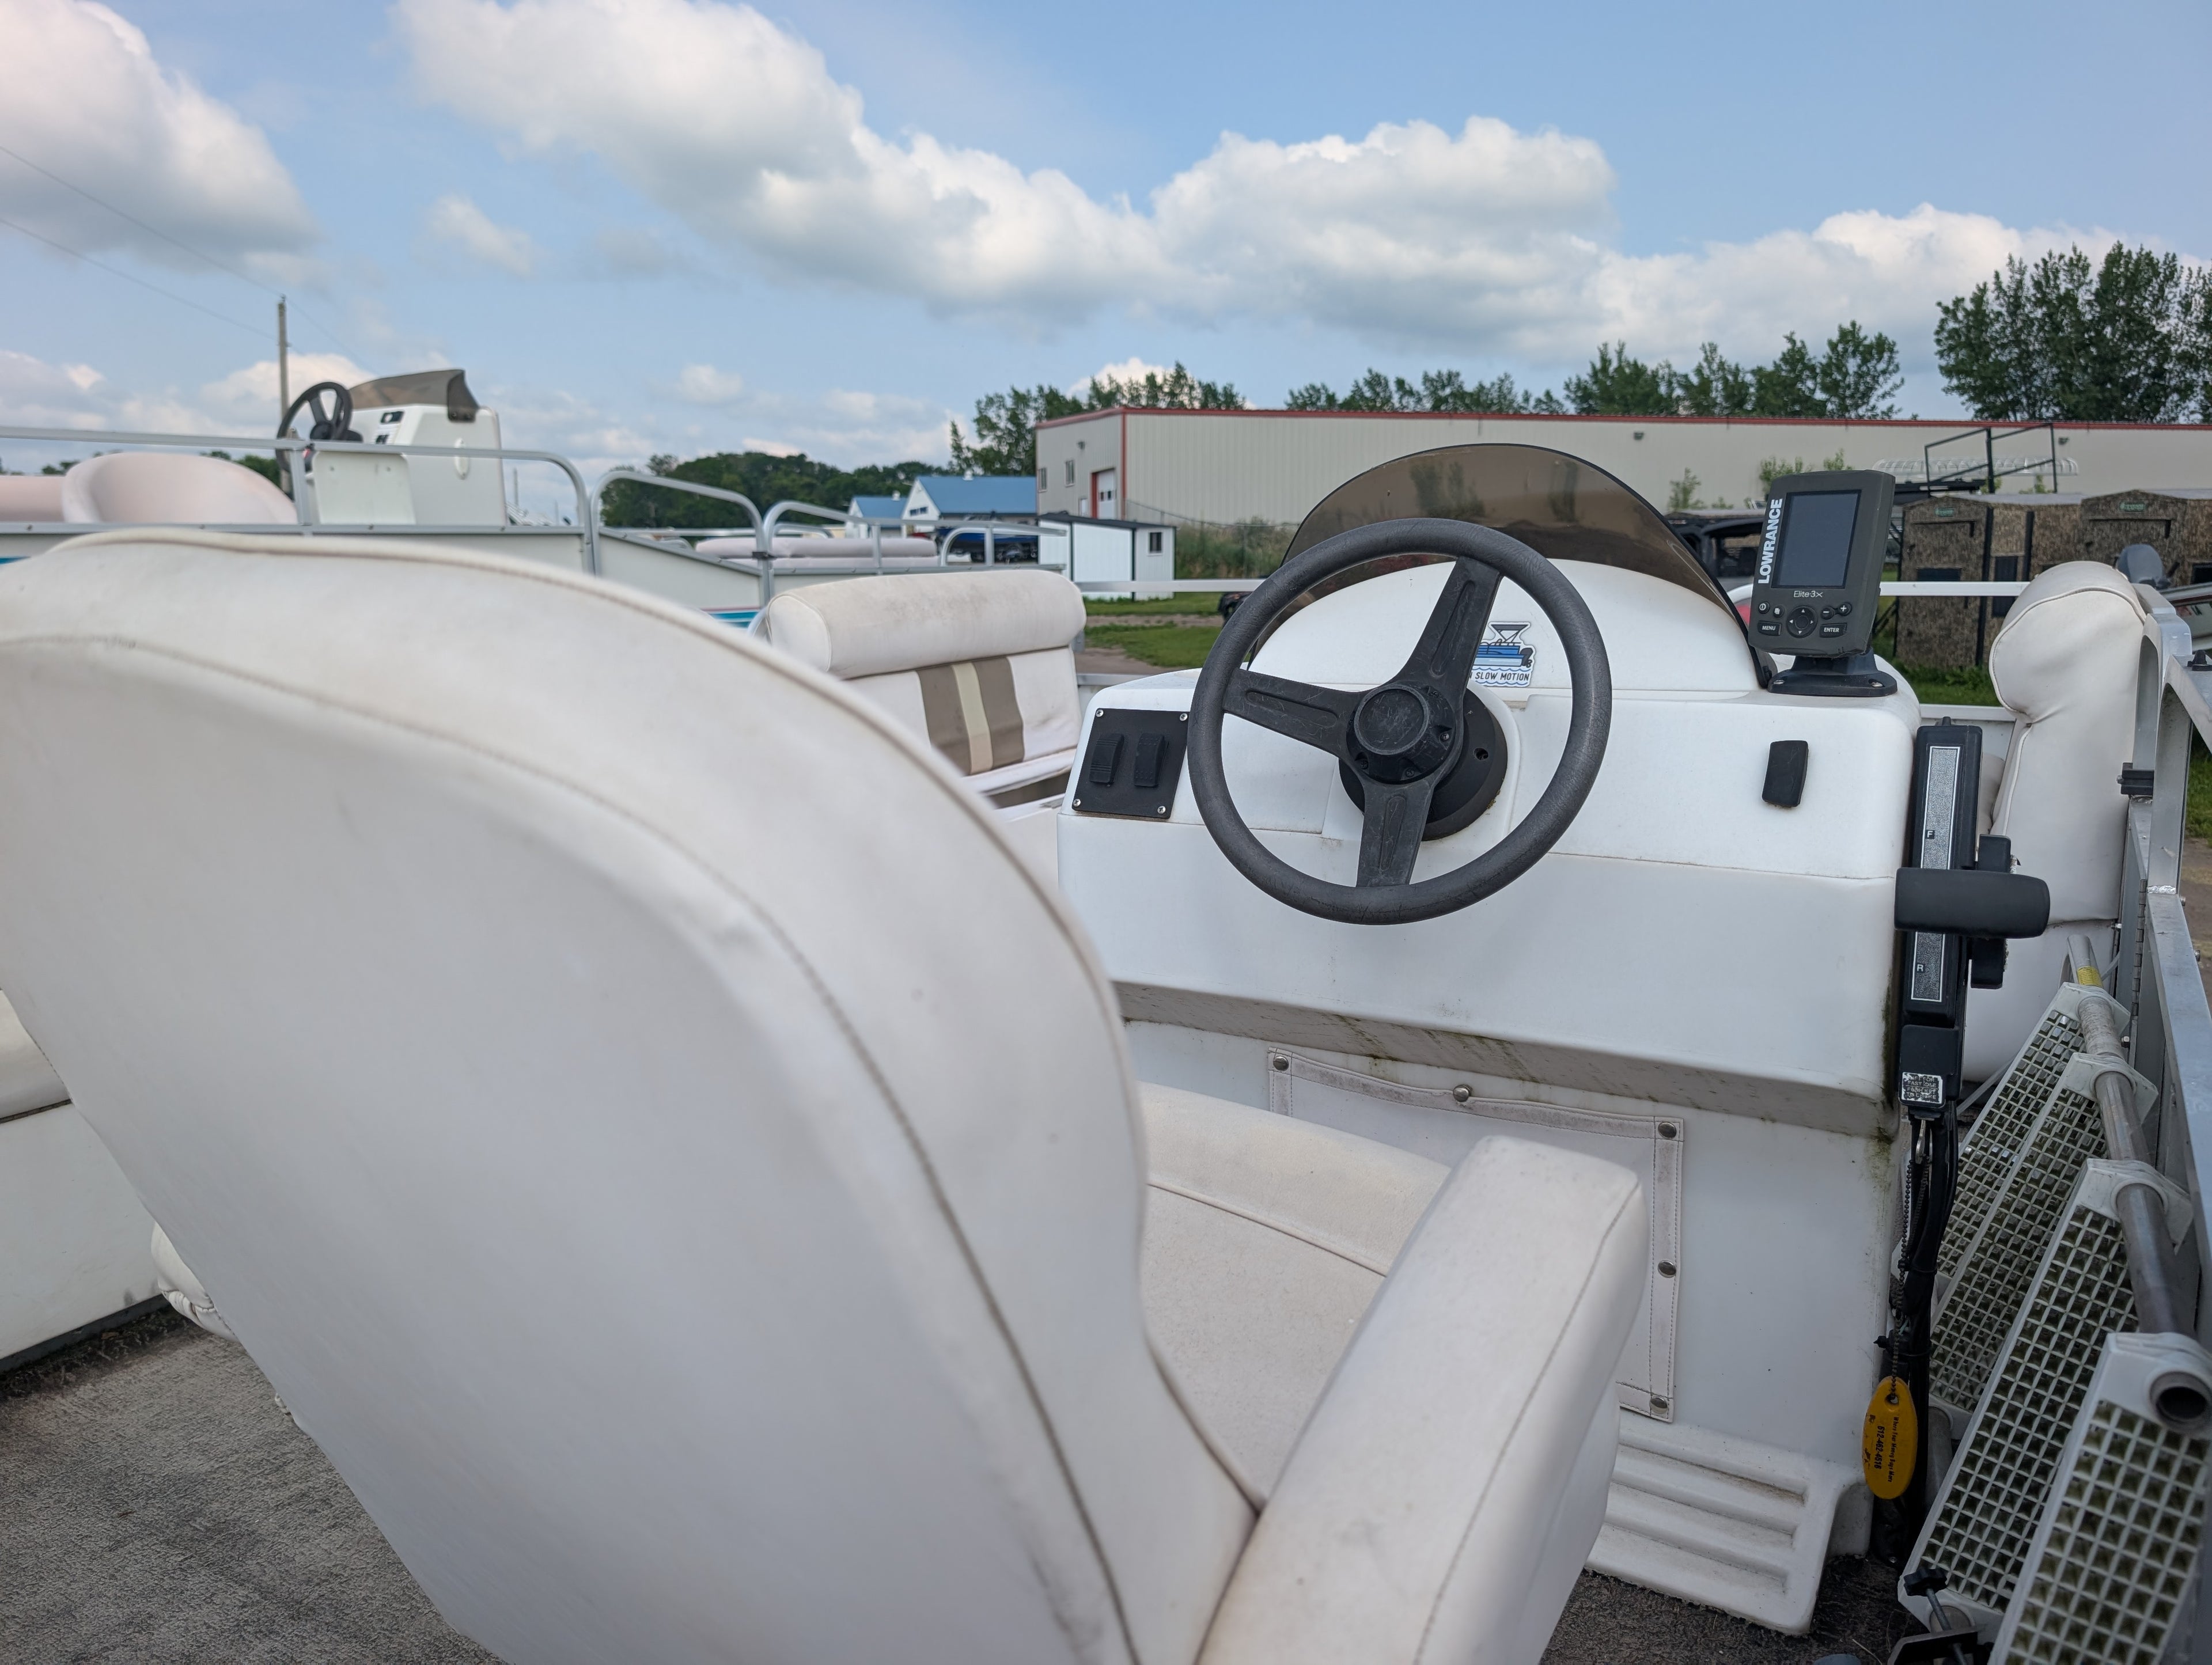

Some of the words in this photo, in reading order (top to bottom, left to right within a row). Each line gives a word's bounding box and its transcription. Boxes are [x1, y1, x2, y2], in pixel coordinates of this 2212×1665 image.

[1758, 498, 1783, 584] LOWRANCE
[1475, 672, 1498, 680] SLOW
[1500, 673, 1530, 681] MOTION
[1927, 830, 1933, 838] F
[1916, 964, 1924, 972] R
[1888, 1458, 1896, 1470] Buys
